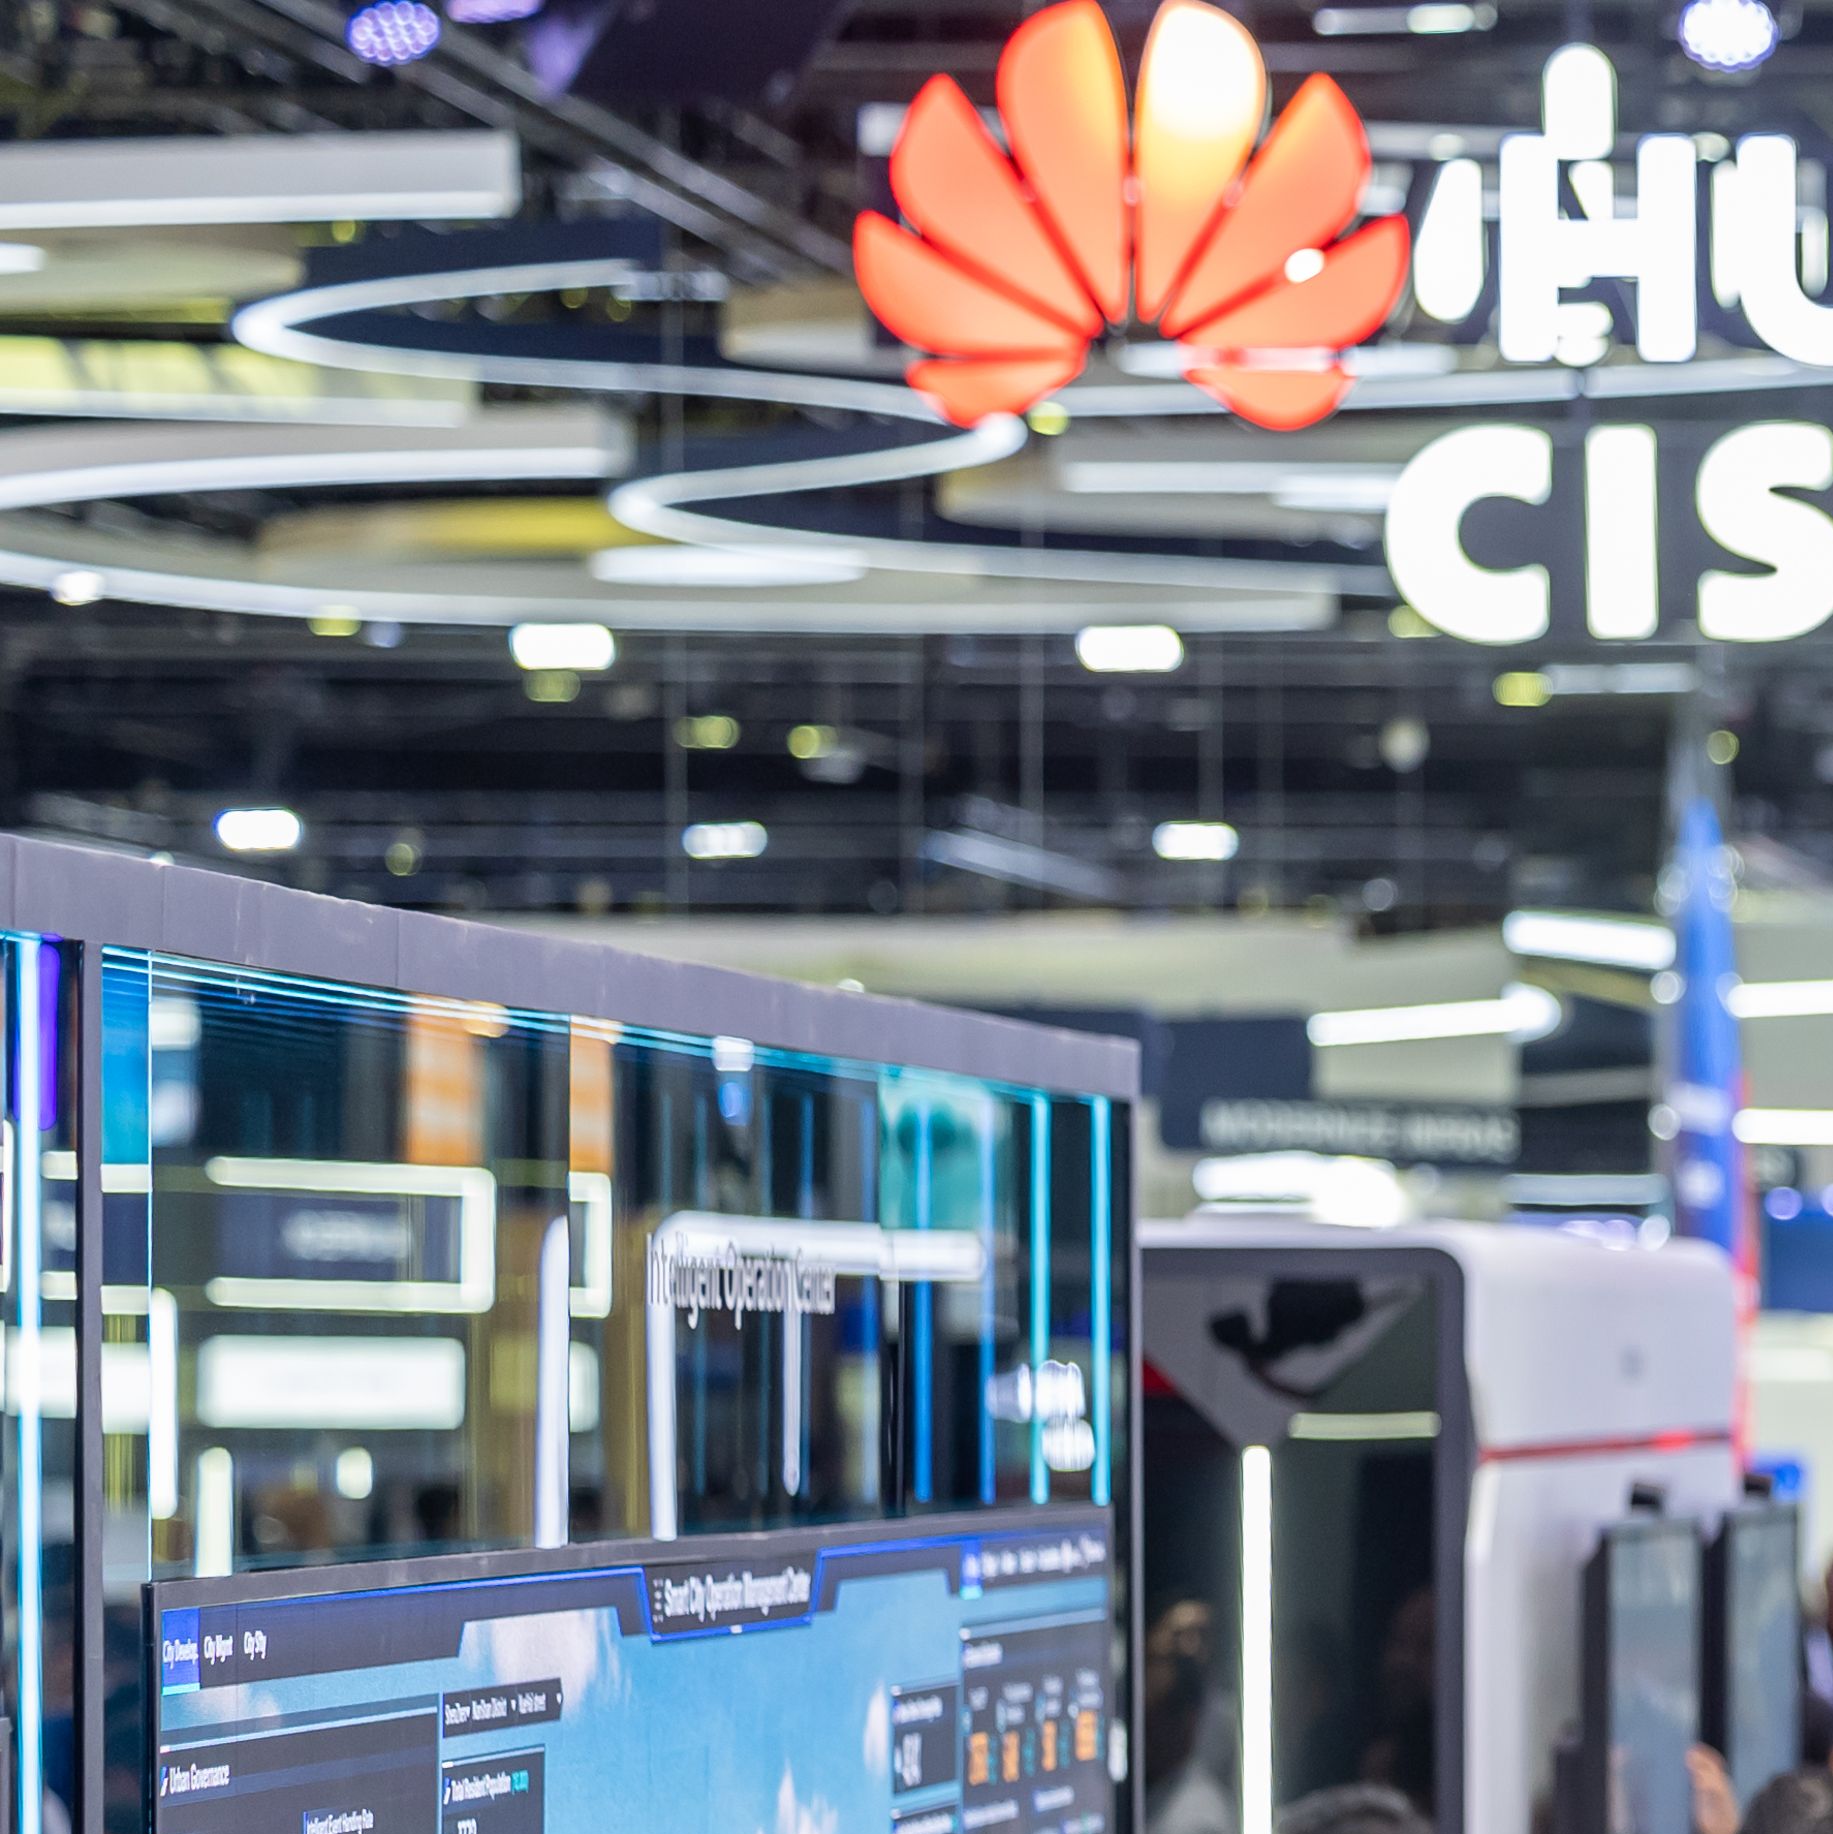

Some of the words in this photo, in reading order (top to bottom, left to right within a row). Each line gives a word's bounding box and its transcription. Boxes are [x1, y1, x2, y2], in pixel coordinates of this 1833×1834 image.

[646, 1231, 722, 1329] Intelligent
[724, 1241, 788, 1330] Operation
[169, 1767, 189, 1793] Urban
[191, 1761, 229, 1788] Governance
